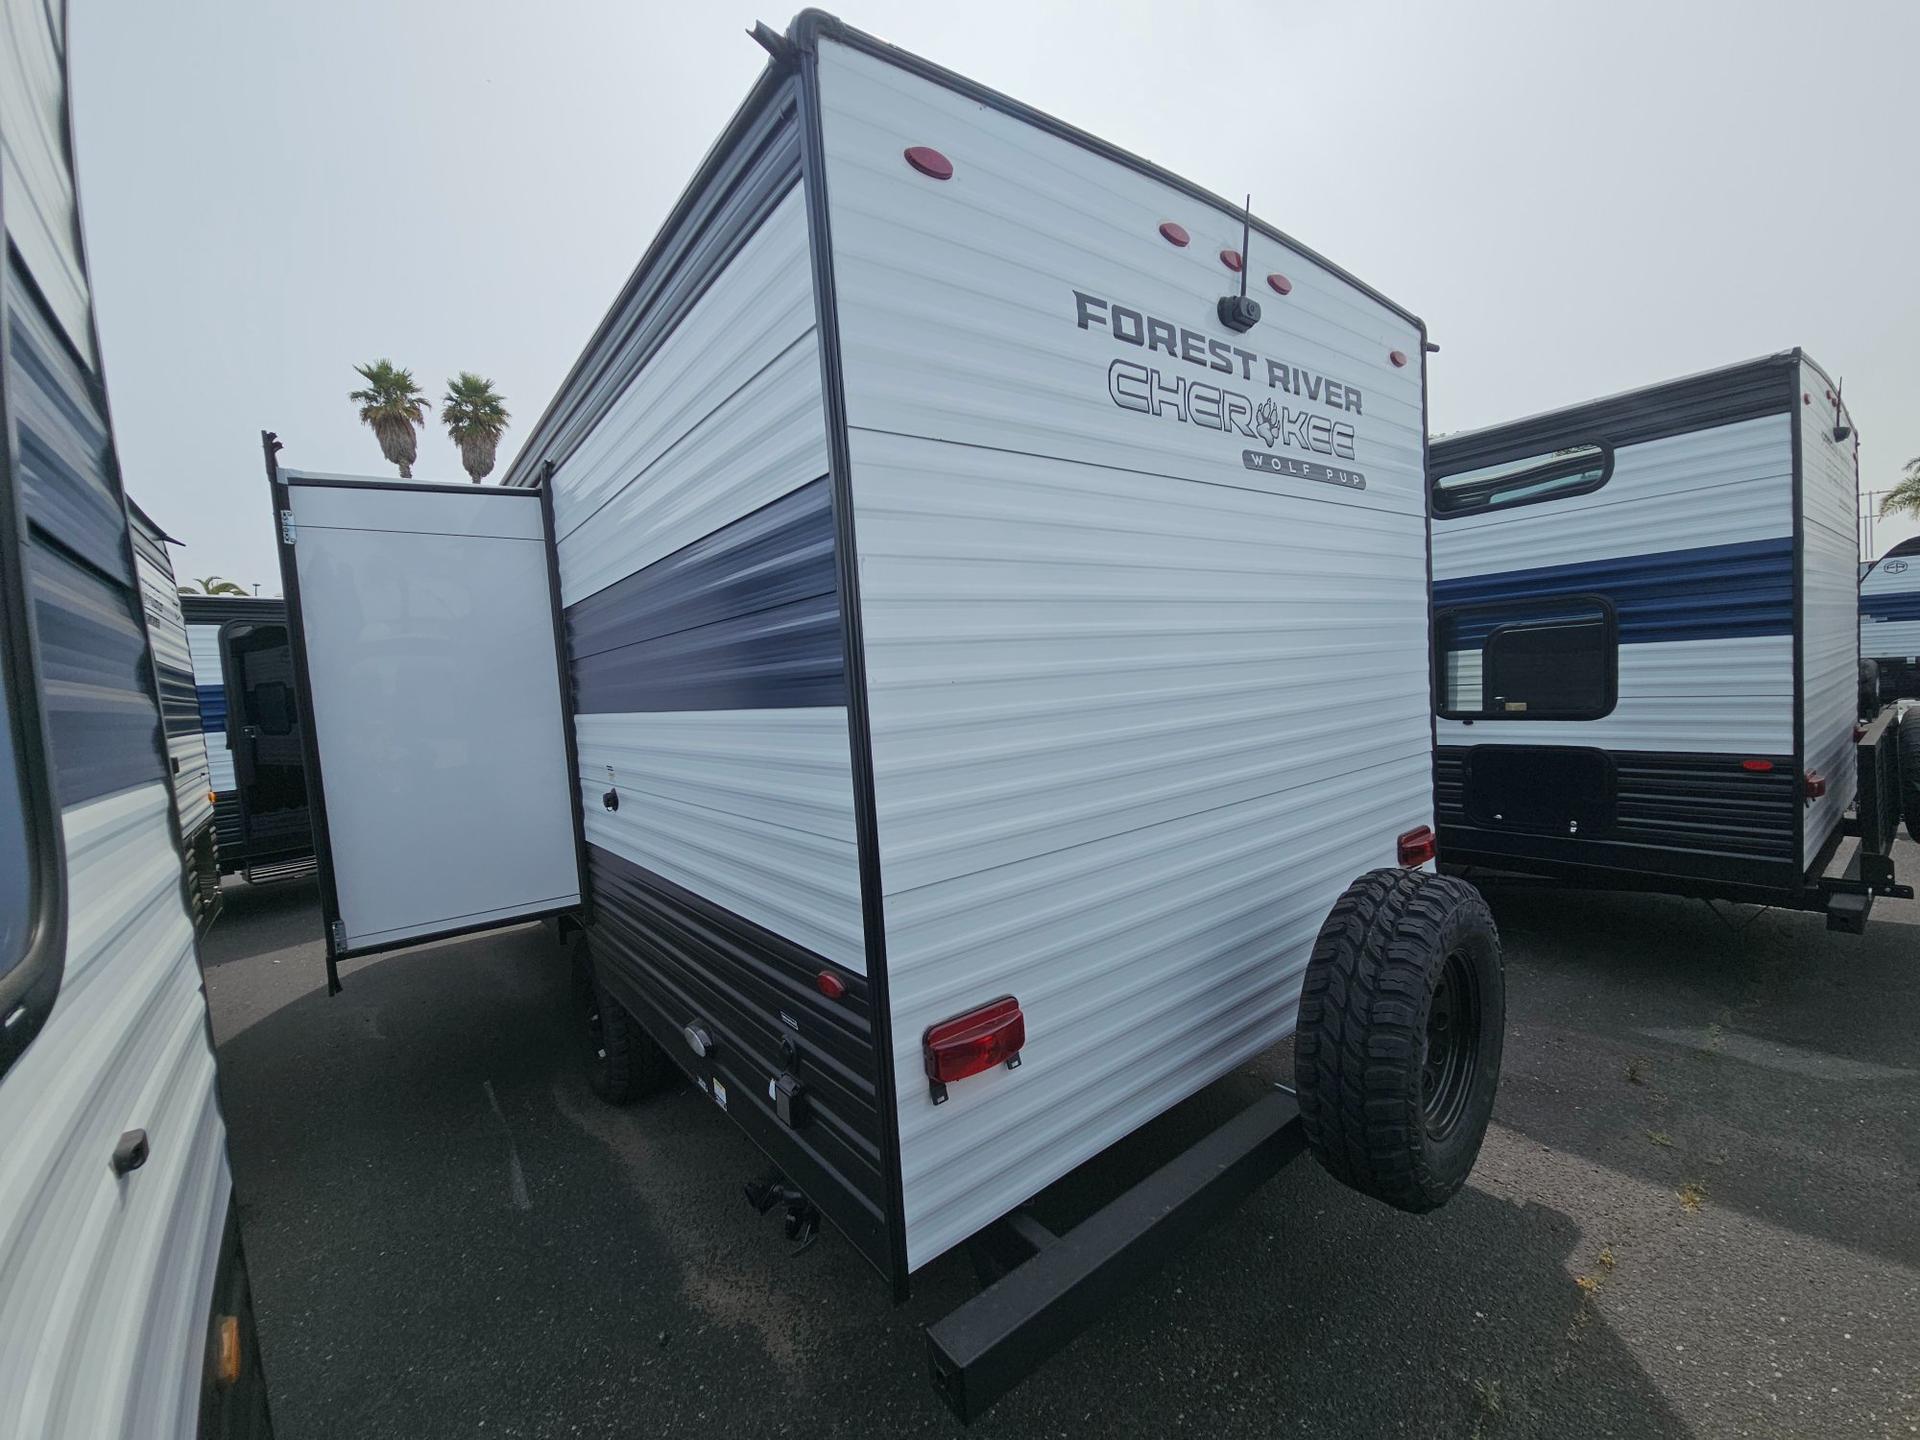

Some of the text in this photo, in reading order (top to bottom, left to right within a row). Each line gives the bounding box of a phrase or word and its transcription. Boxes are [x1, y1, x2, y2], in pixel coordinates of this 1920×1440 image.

[1072, 290, 1362, 415] FOREST RIVER
[1251, 454, 1360, 485] WOLF PUP
